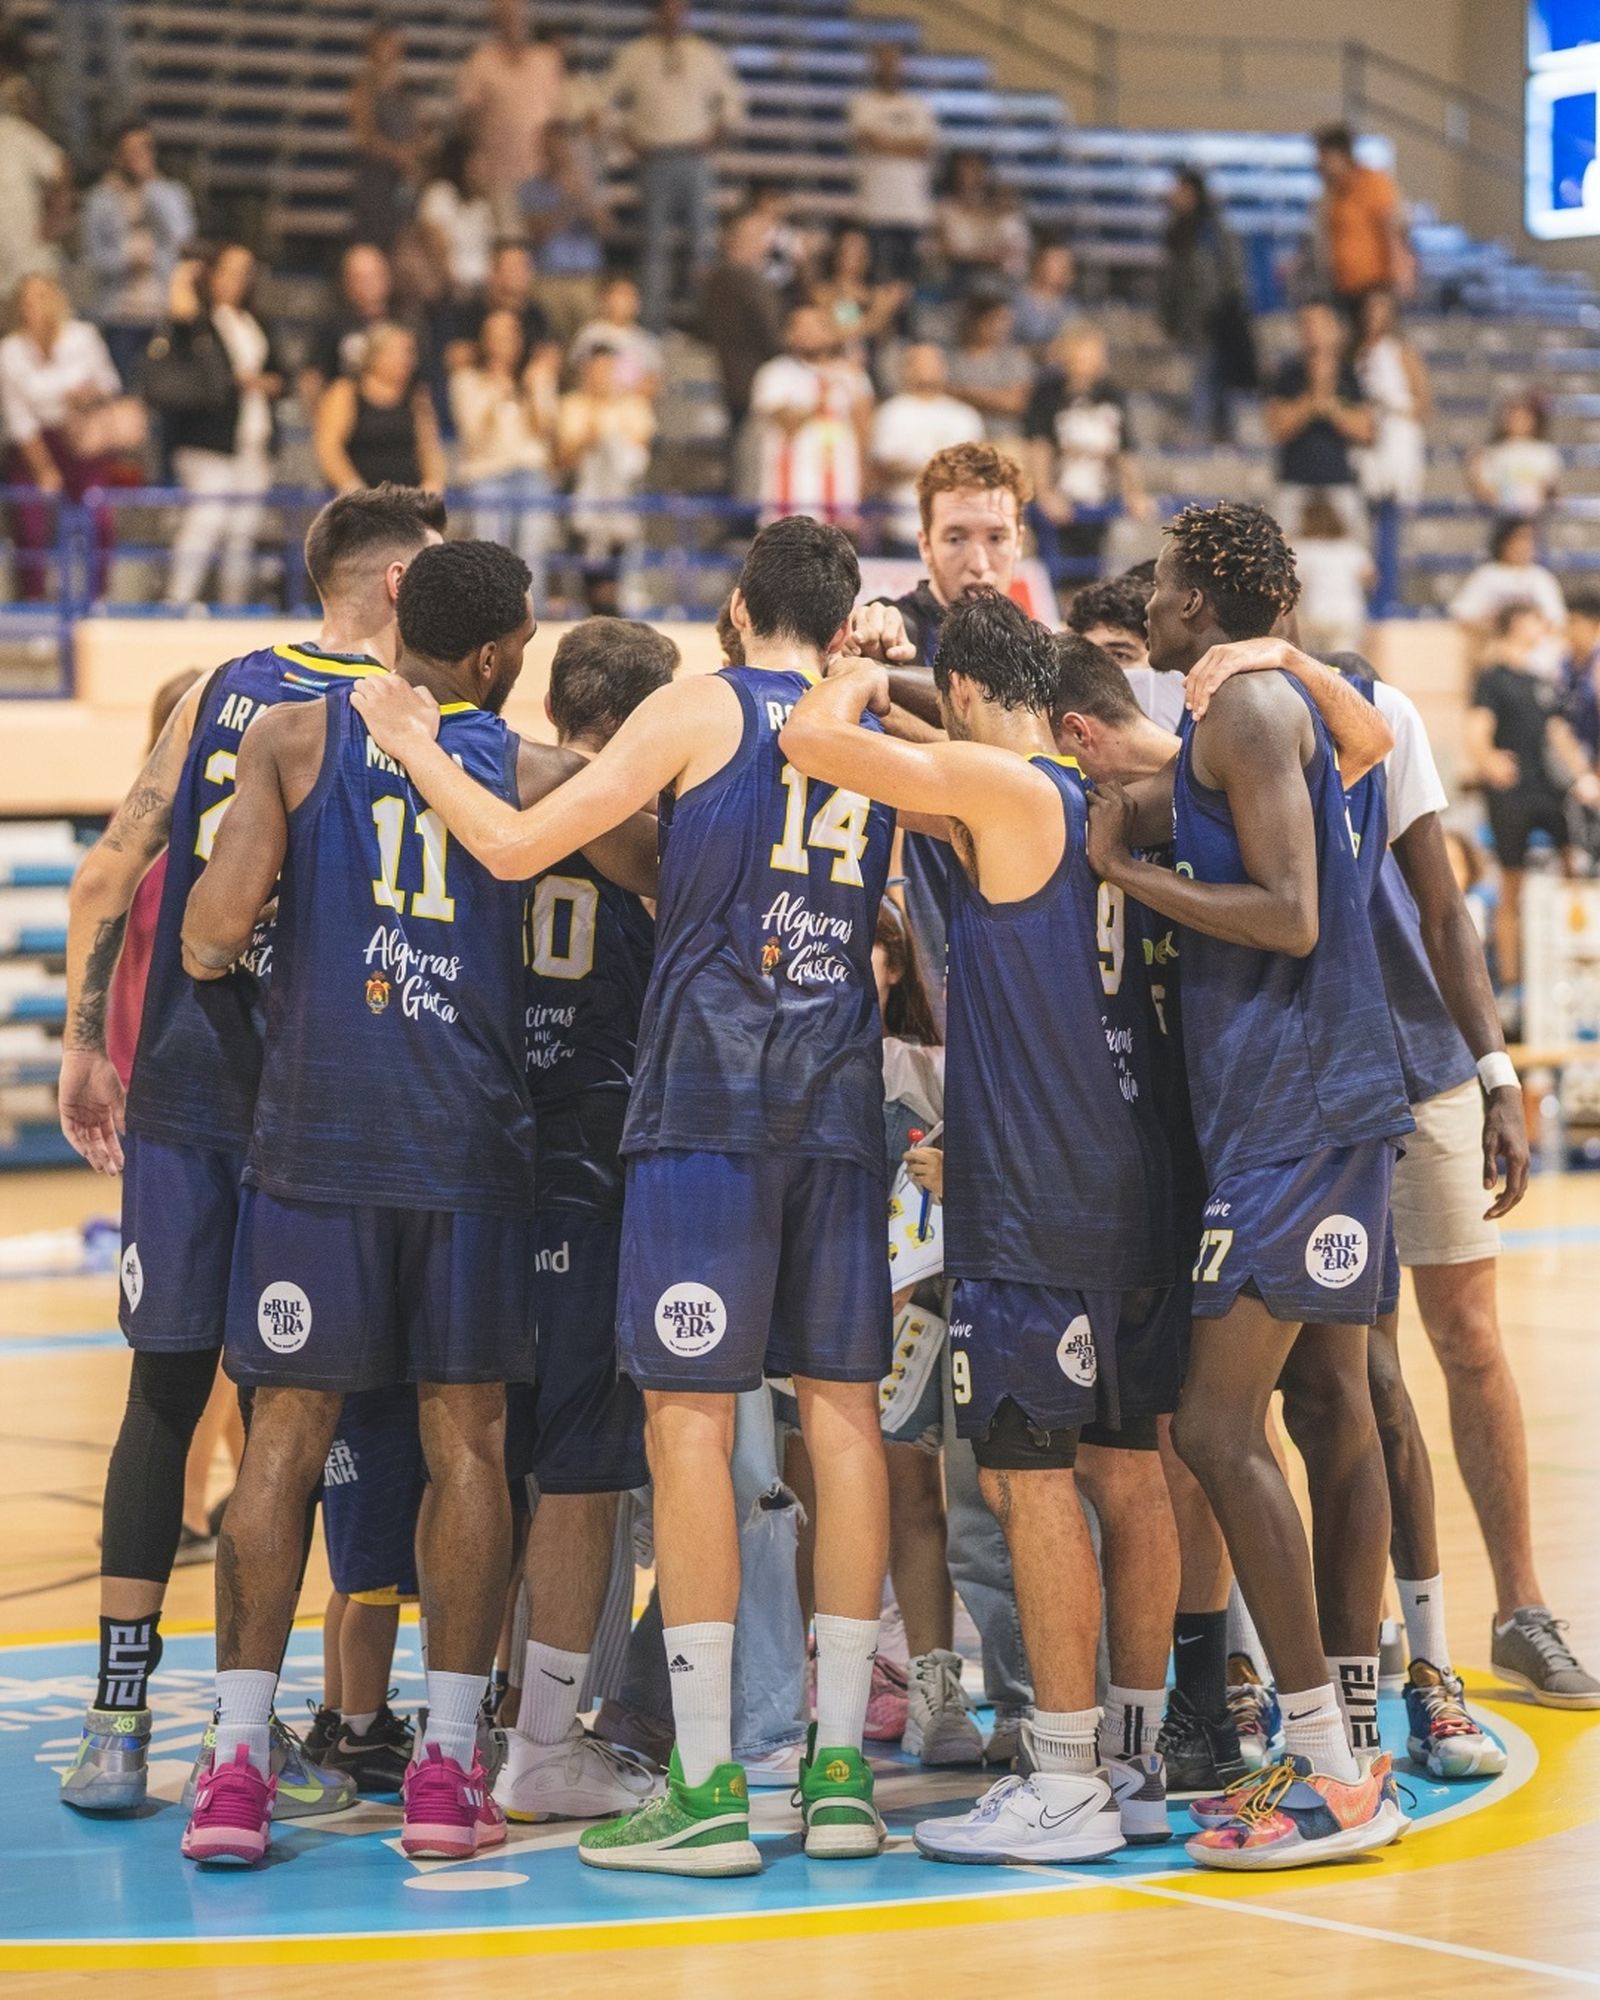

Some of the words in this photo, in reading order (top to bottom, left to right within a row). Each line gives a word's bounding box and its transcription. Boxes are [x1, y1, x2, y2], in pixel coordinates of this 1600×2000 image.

[371, 794, 455, 922] 11
[769, 762, 871, 887] 14
[523, 875, 599, 980] 0
[953, 1351, 972, 1405] 9
